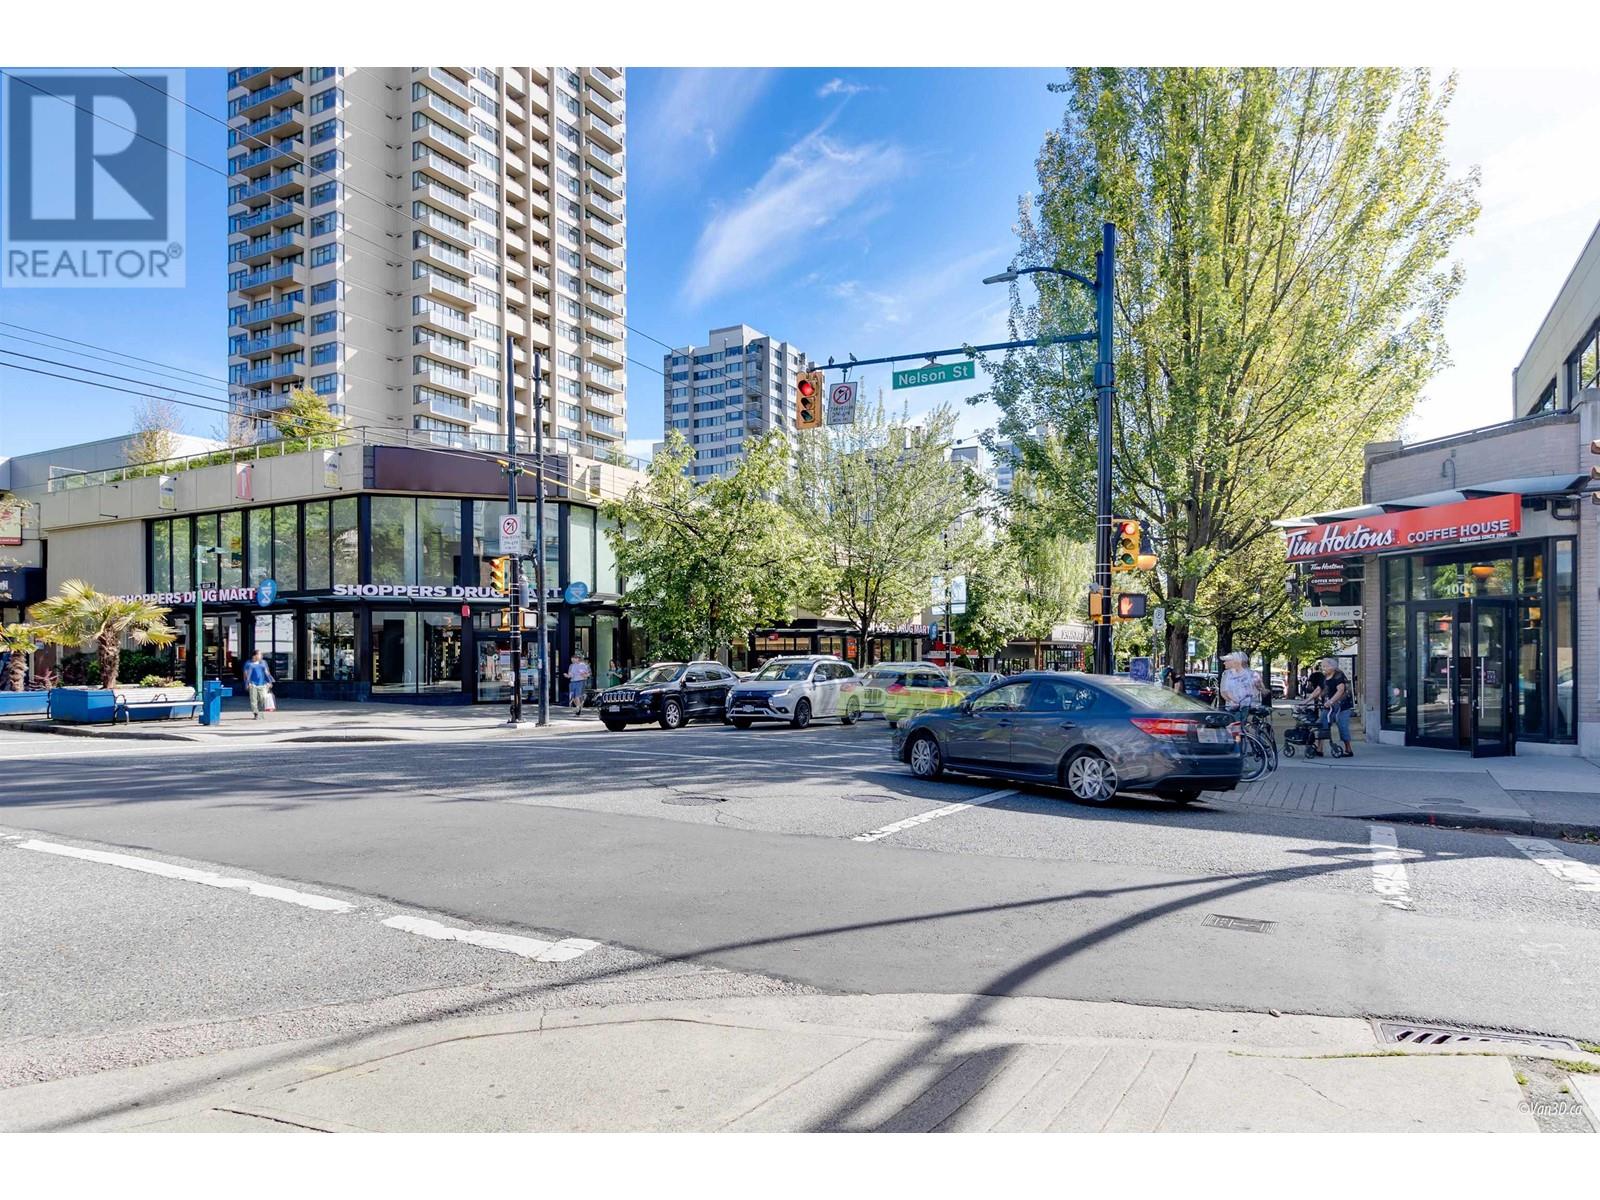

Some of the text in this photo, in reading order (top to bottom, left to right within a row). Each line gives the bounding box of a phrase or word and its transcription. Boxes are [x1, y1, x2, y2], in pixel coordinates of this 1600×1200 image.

[899, 365, 968, 386] Nelson St
[1407, 519, 1510, 543] COFFEE HOUSE
[1286, 524, 1392, 558] Tim Hortons
[1321, 562, 1344, 570] Hortons
[219, 587, 255, 601] MART
[332, 584, 562, 598] SHOPPERS DRUG ART
